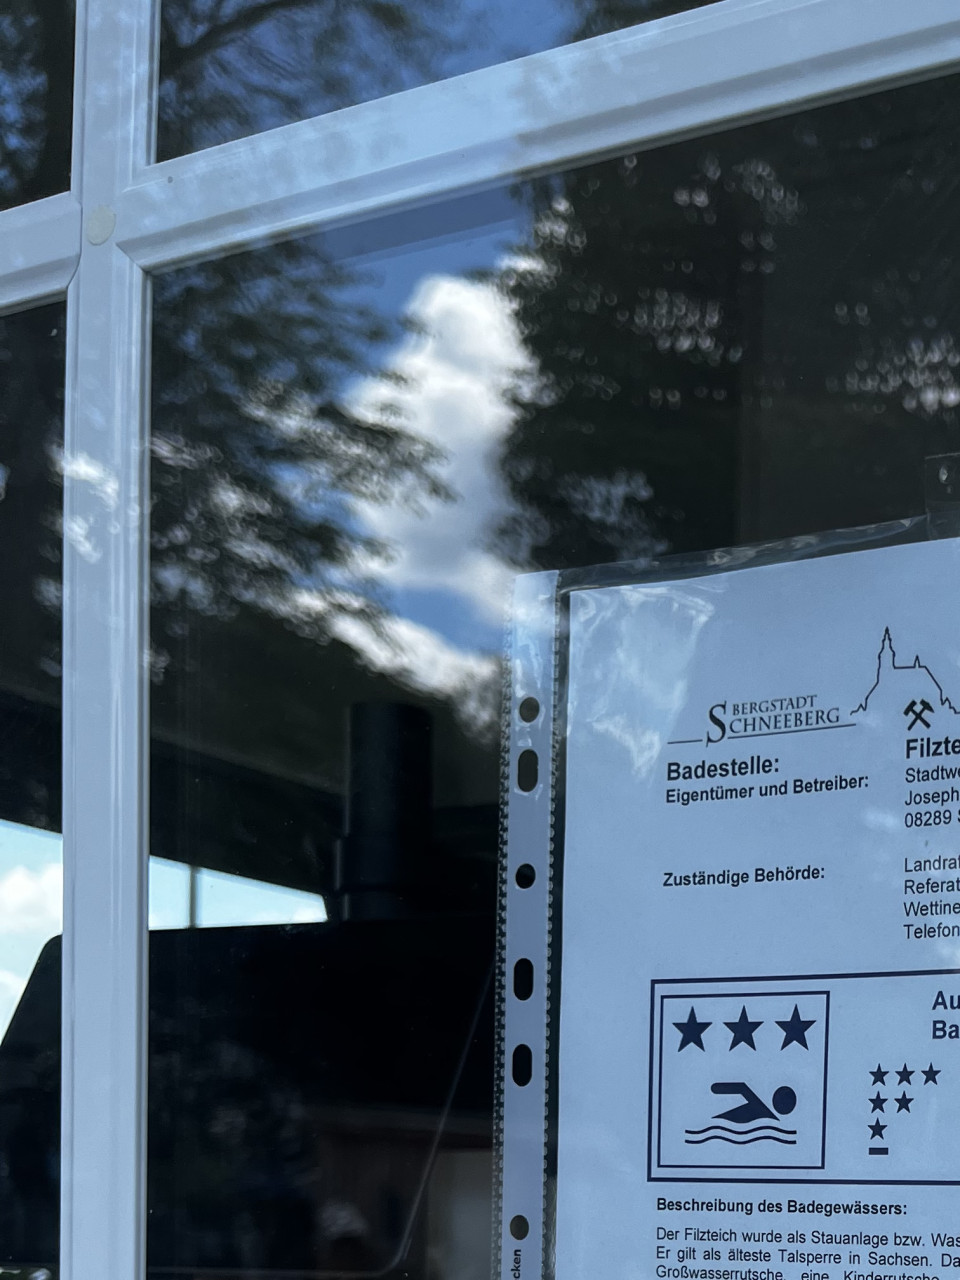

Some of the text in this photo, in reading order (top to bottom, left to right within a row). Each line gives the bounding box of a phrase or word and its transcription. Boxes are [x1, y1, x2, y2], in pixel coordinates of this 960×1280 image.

[732, 694, 817, 716] BERGSTADT
[705, 700, 841, 747] SCHNEEBERG
[667, 755, 778, 781] Badestelle:
[666, 774, 868, 806] Eigentümer und Betreiber:
[904, 808, 952, 828] 08289
[662, 864, 824, 887] Zuständige Behörde:
[904, 877, 960, 895] Referat
[656, 1197, 906, 1217] Beschreibung des Badegewässers:
[656, 1226, 680, 1240] Der
[684, 1227, 737, 1242] Filzteich
[741, 1229, 782, 1243] wurde
[786, 1230, 806, 1244] als
[811, 1230, 888, 1249] Stauanlage
[893, 1232, 925, 1246] bzw.
